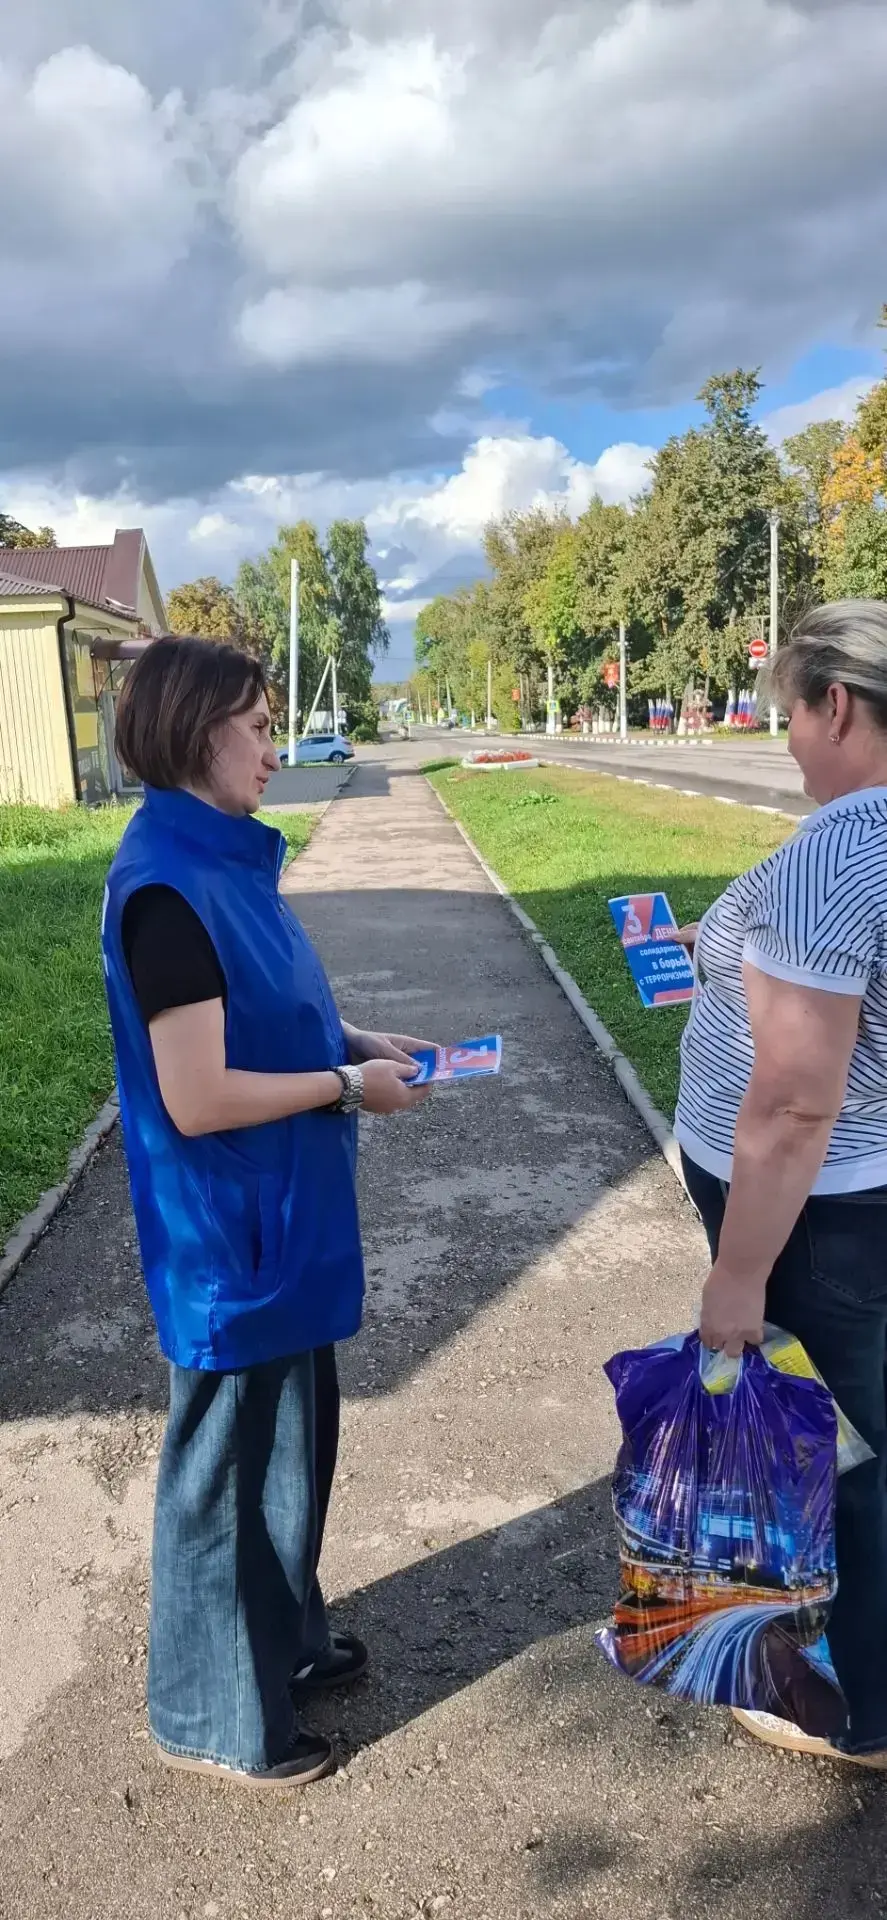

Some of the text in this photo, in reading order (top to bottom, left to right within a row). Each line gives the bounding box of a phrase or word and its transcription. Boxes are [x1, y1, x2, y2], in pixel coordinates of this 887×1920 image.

[621, 904, 642, 934] 3
[652, 961, 659, 970] в
[449, 1044, 488, 1063] 3
